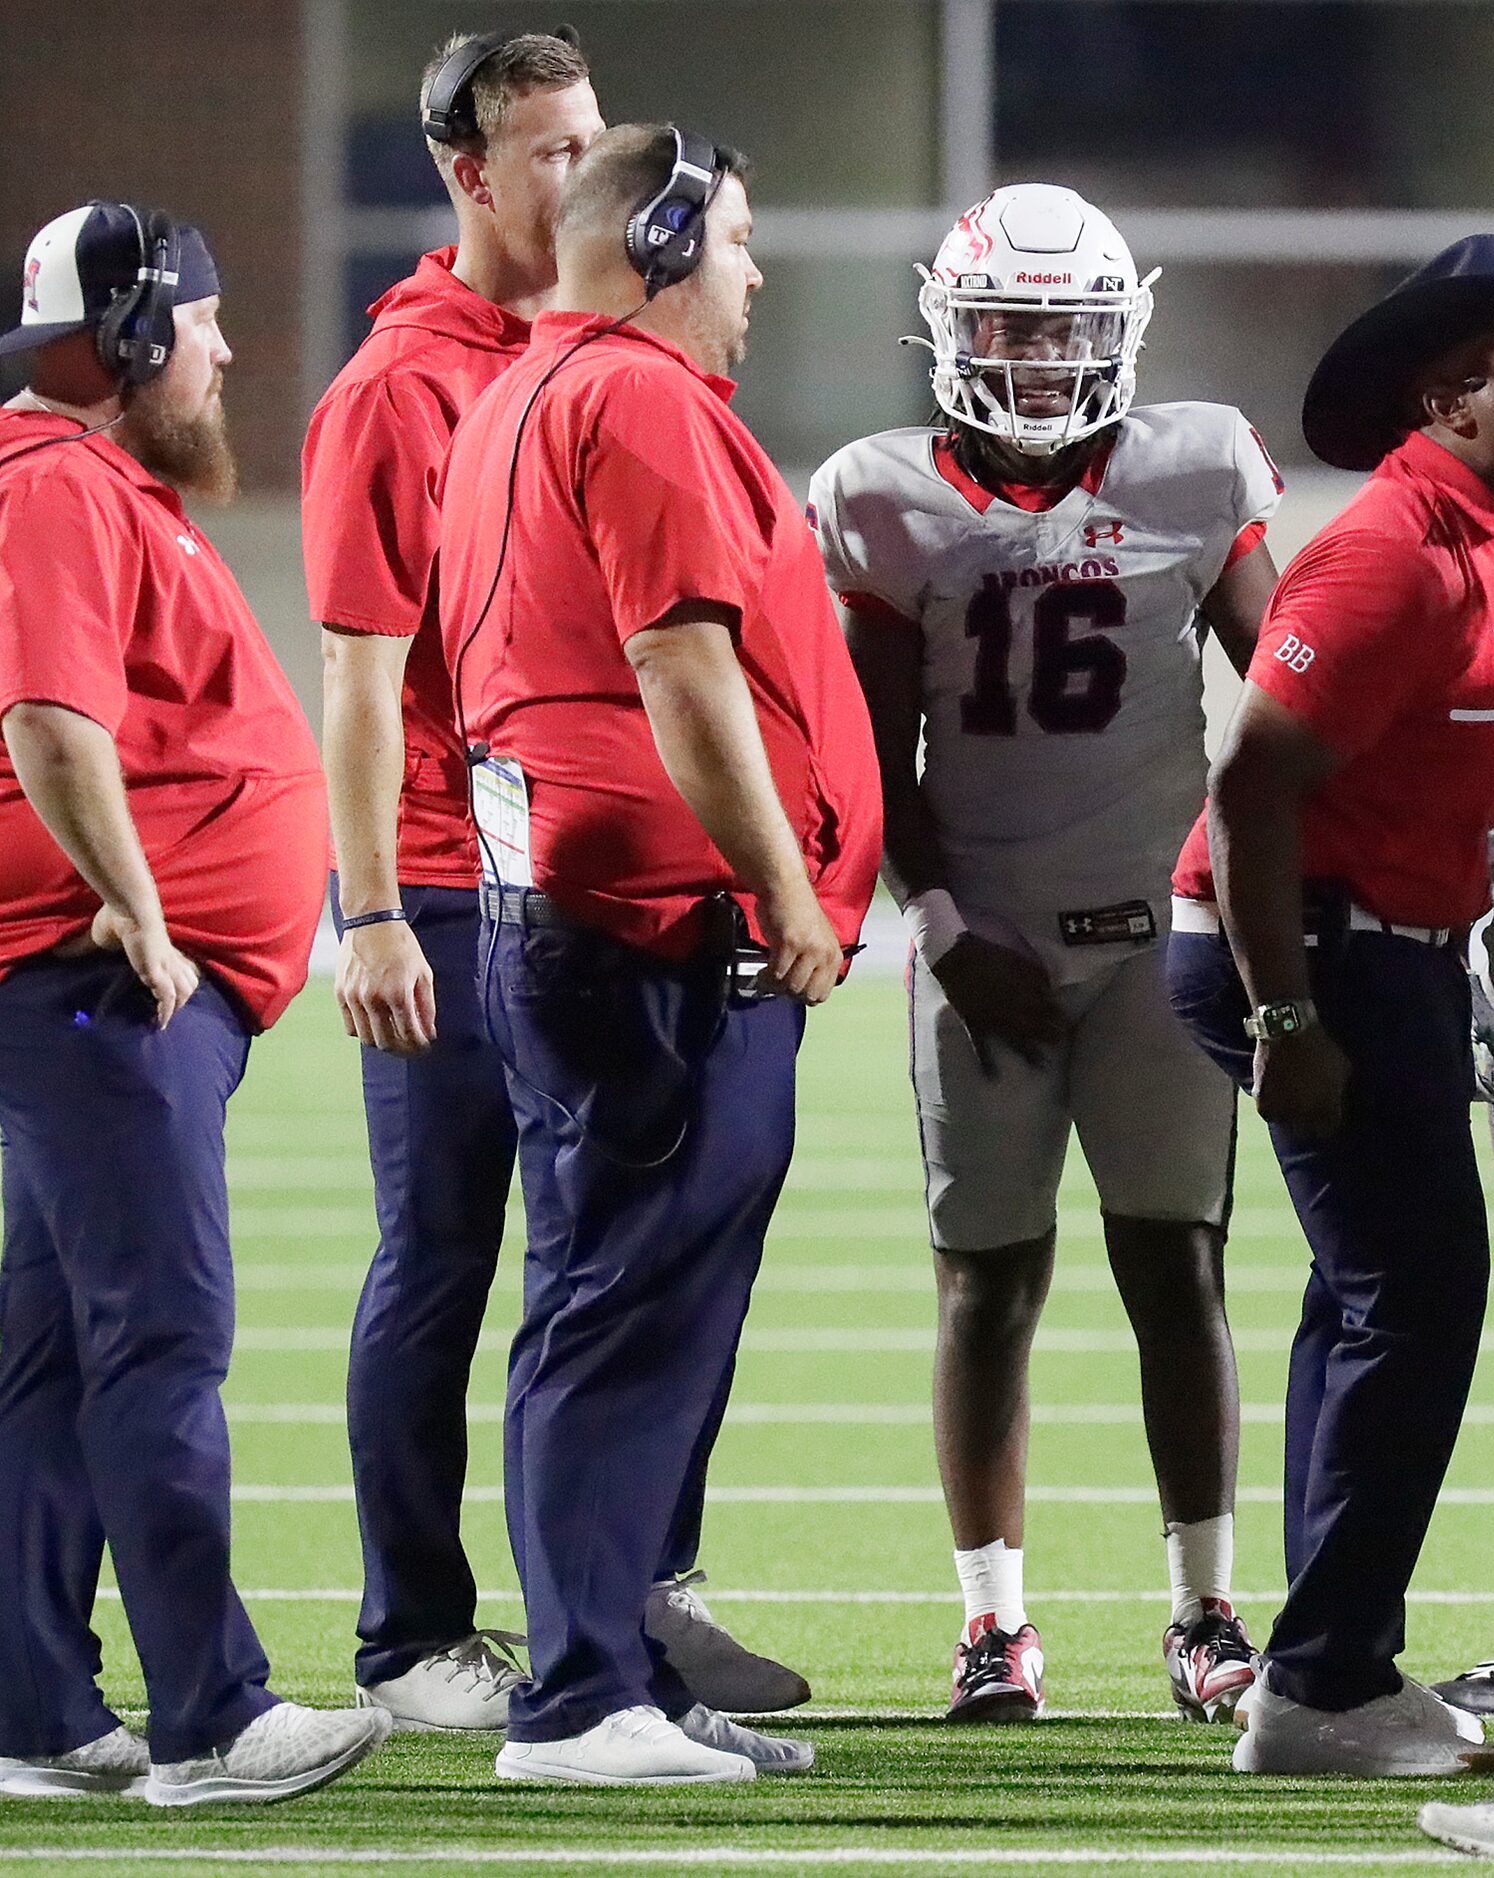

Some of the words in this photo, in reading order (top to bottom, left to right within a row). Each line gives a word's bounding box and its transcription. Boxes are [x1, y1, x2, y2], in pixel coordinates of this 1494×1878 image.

[1016, 271, 1072, 285] Riddell
[1023, 423, 1053, 432] Riddell
[958, 577, 1128, 737] 16
[1273, 633, 1316, 673] BB
